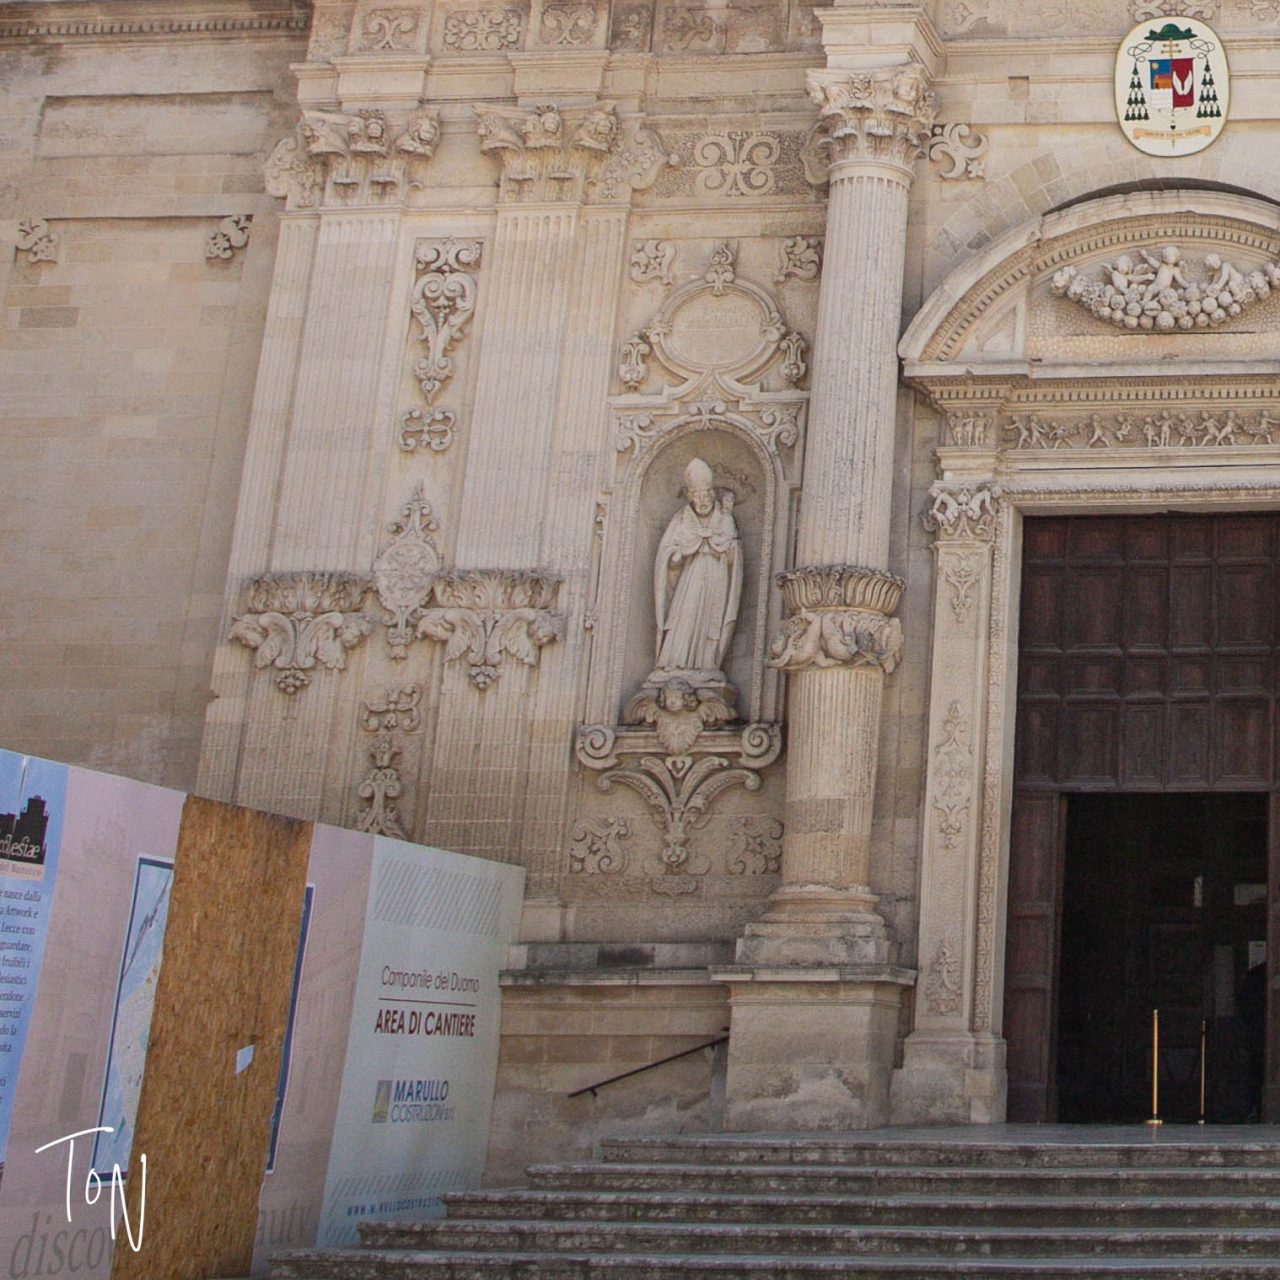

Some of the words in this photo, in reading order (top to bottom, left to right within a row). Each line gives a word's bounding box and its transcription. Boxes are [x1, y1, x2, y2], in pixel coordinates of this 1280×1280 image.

[381, 965, 433, 991] Campanile
[434, 970, 450, 991] del
[451, 972, 480, 993] Duomo
[374, 1008, 406, 1034] AREA
[408, 1011, 422, 1035] DI
[424, 1012, 476, 1037] CANTIERE
[394, 1079, 450, 1102] MARULLO
